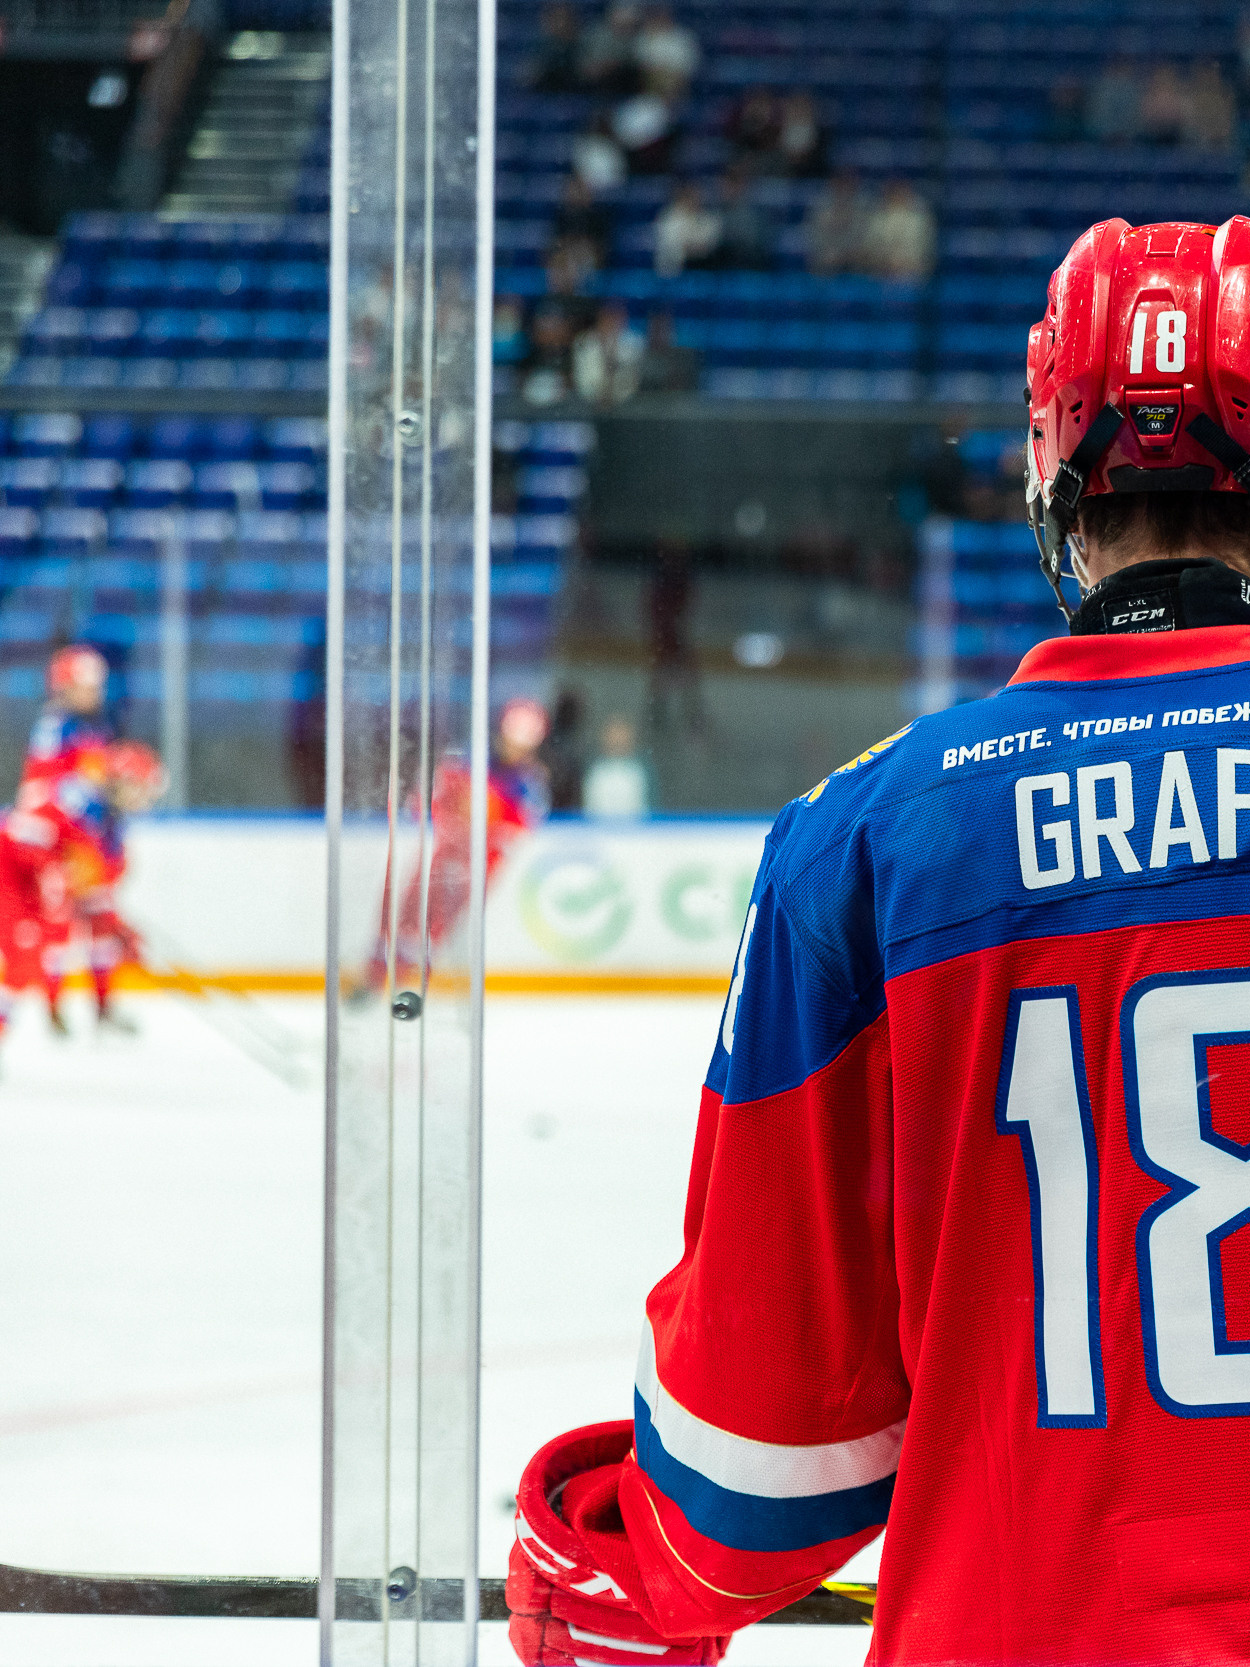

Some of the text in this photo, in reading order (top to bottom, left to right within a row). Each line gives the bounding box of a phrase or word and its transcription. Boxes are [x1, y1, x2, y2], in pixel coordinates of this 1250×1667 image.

[1129, 310, 1187, 374] 18
[1137, 406, 1175, 415] TACKS
[1111, 607, 1166, 627] CCM
[942, 727, 1052, 771] ВМЕСТЕ.
[1062, 713, 1154, 741] ЧТОБЫ
